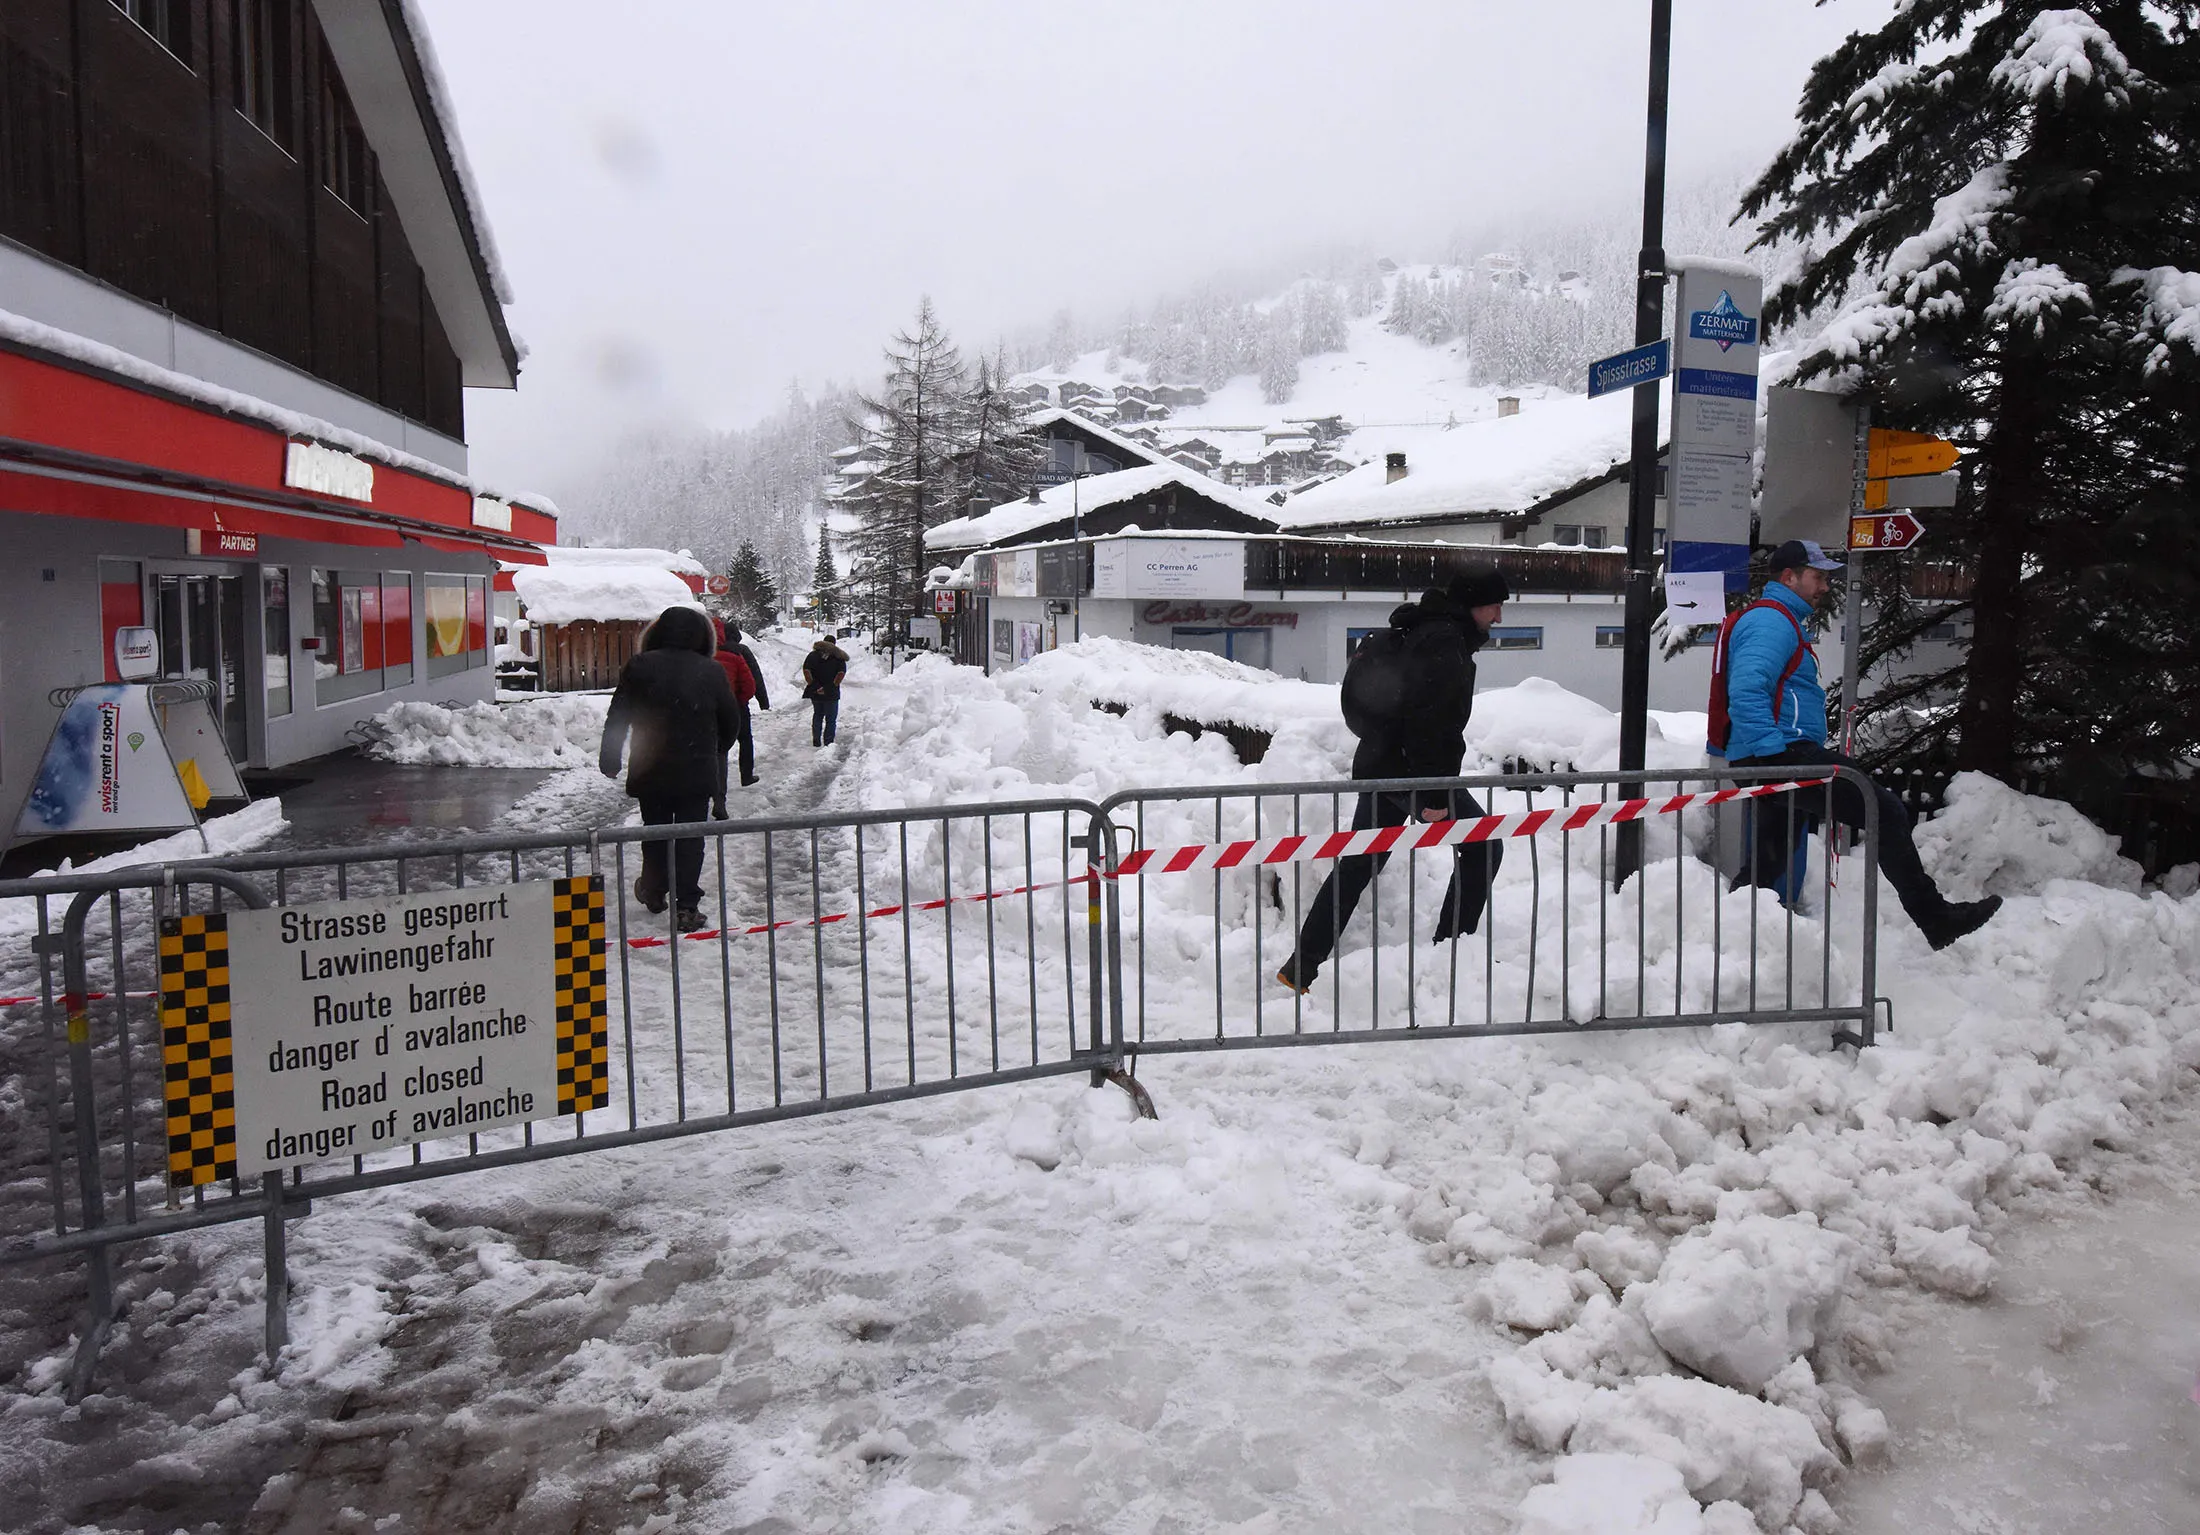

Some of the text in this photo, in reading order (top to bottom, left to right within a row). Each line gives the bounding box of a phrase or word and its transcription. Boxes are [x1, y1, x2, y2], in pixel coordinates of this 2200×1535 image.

[1698, 314, 1750, 332] ZERMATT
[1702, 328, 1745, 340] MATTERHORN
[1596, 354, 1657, 391] Spissstrasse
[220, 534, 256, 551] PARTNER
[1855, 532, 1874, 544] 150
[1146, 563, 1158, 571] CC
[1159, 563, 1185, 571] Perren
[101, 709, 115, 742] sport
[102, 743, 113, 754] a
[111, 789, 119, 801] and
[112, 780, 120, 789] go
[280, 892, 509, 944] Strasse gesperrt
[300, 929, 495, 982] Lawinengefahr
[313, 981, 486, 1028] Route barrée
[268, 1038, 360, 1073] danger
[405, 1007, 527, 1052] avalanche
[321, 1056, 483, 1112] Road closed
[266, 1087, 534, 1161] danger of avalanche
